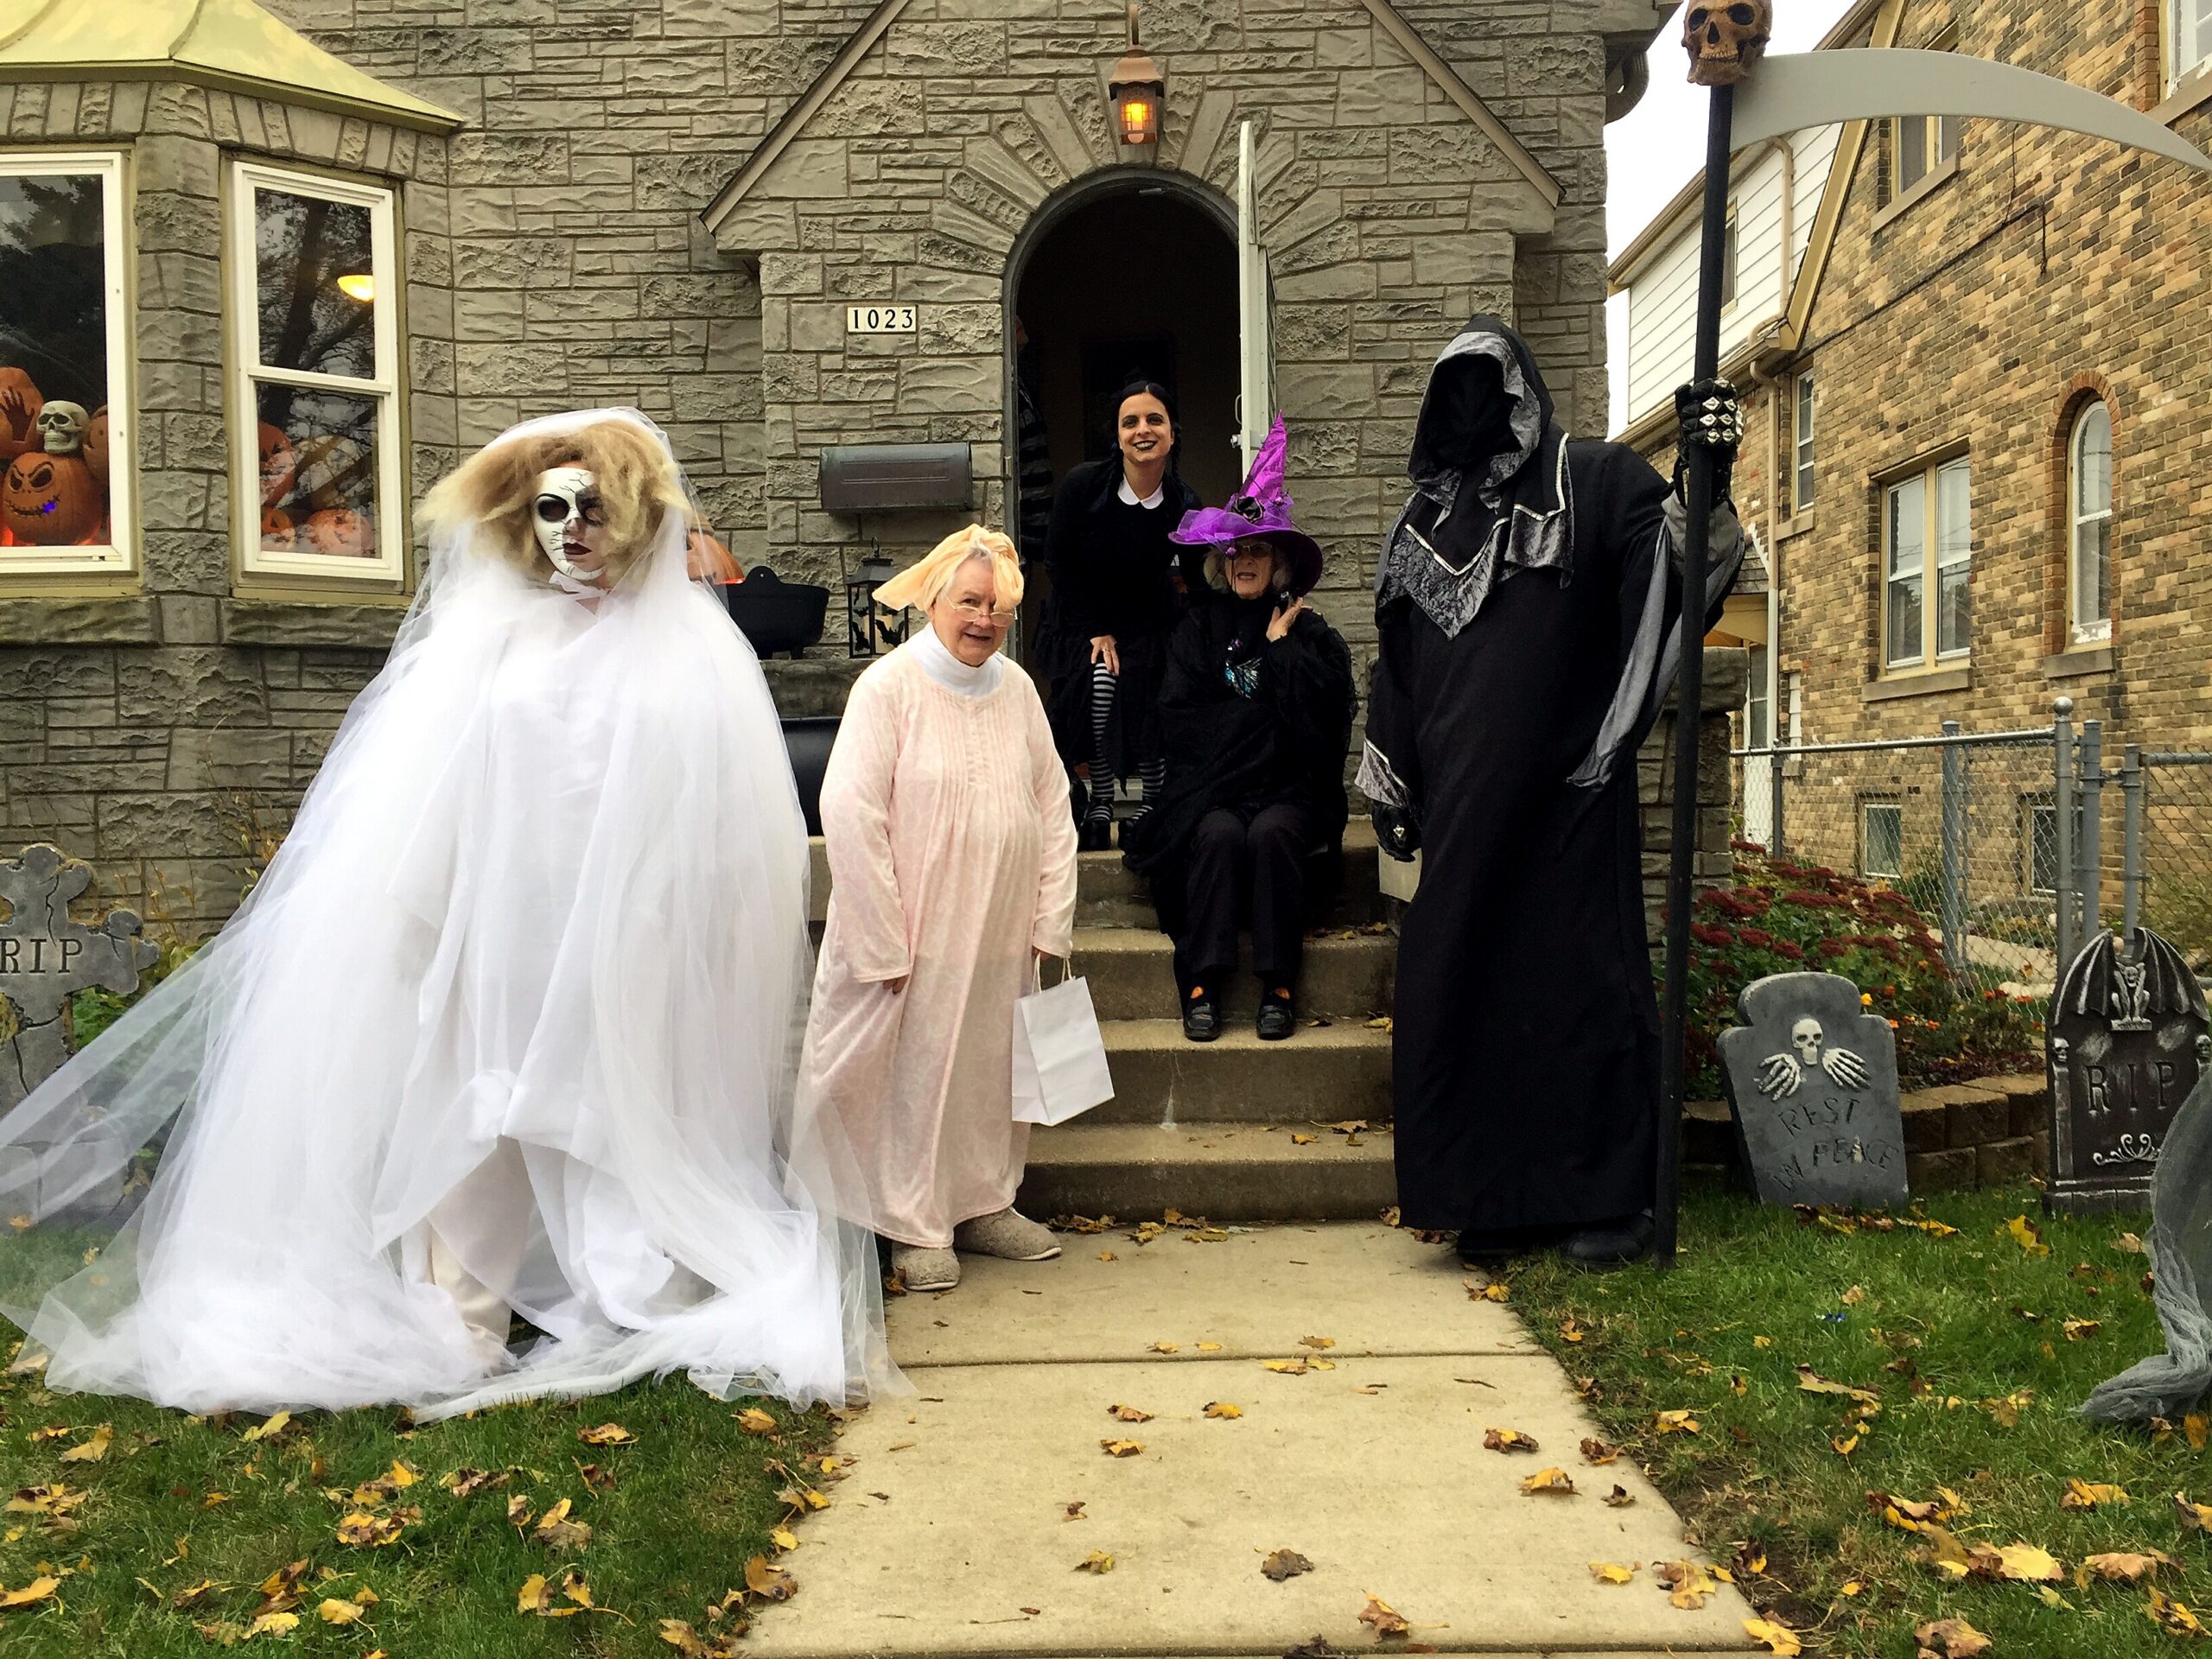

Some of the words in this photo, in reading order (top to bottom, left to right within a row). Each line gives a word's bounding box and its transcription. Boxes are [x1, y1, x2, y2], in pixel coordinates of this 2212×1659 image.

[854, 308, 913, 329] 1023
[0, 938, 83, 974] RIP
[2085, 1061, 2177, 1112] RIP
[1777, 1097, 1860, 1139] REST
